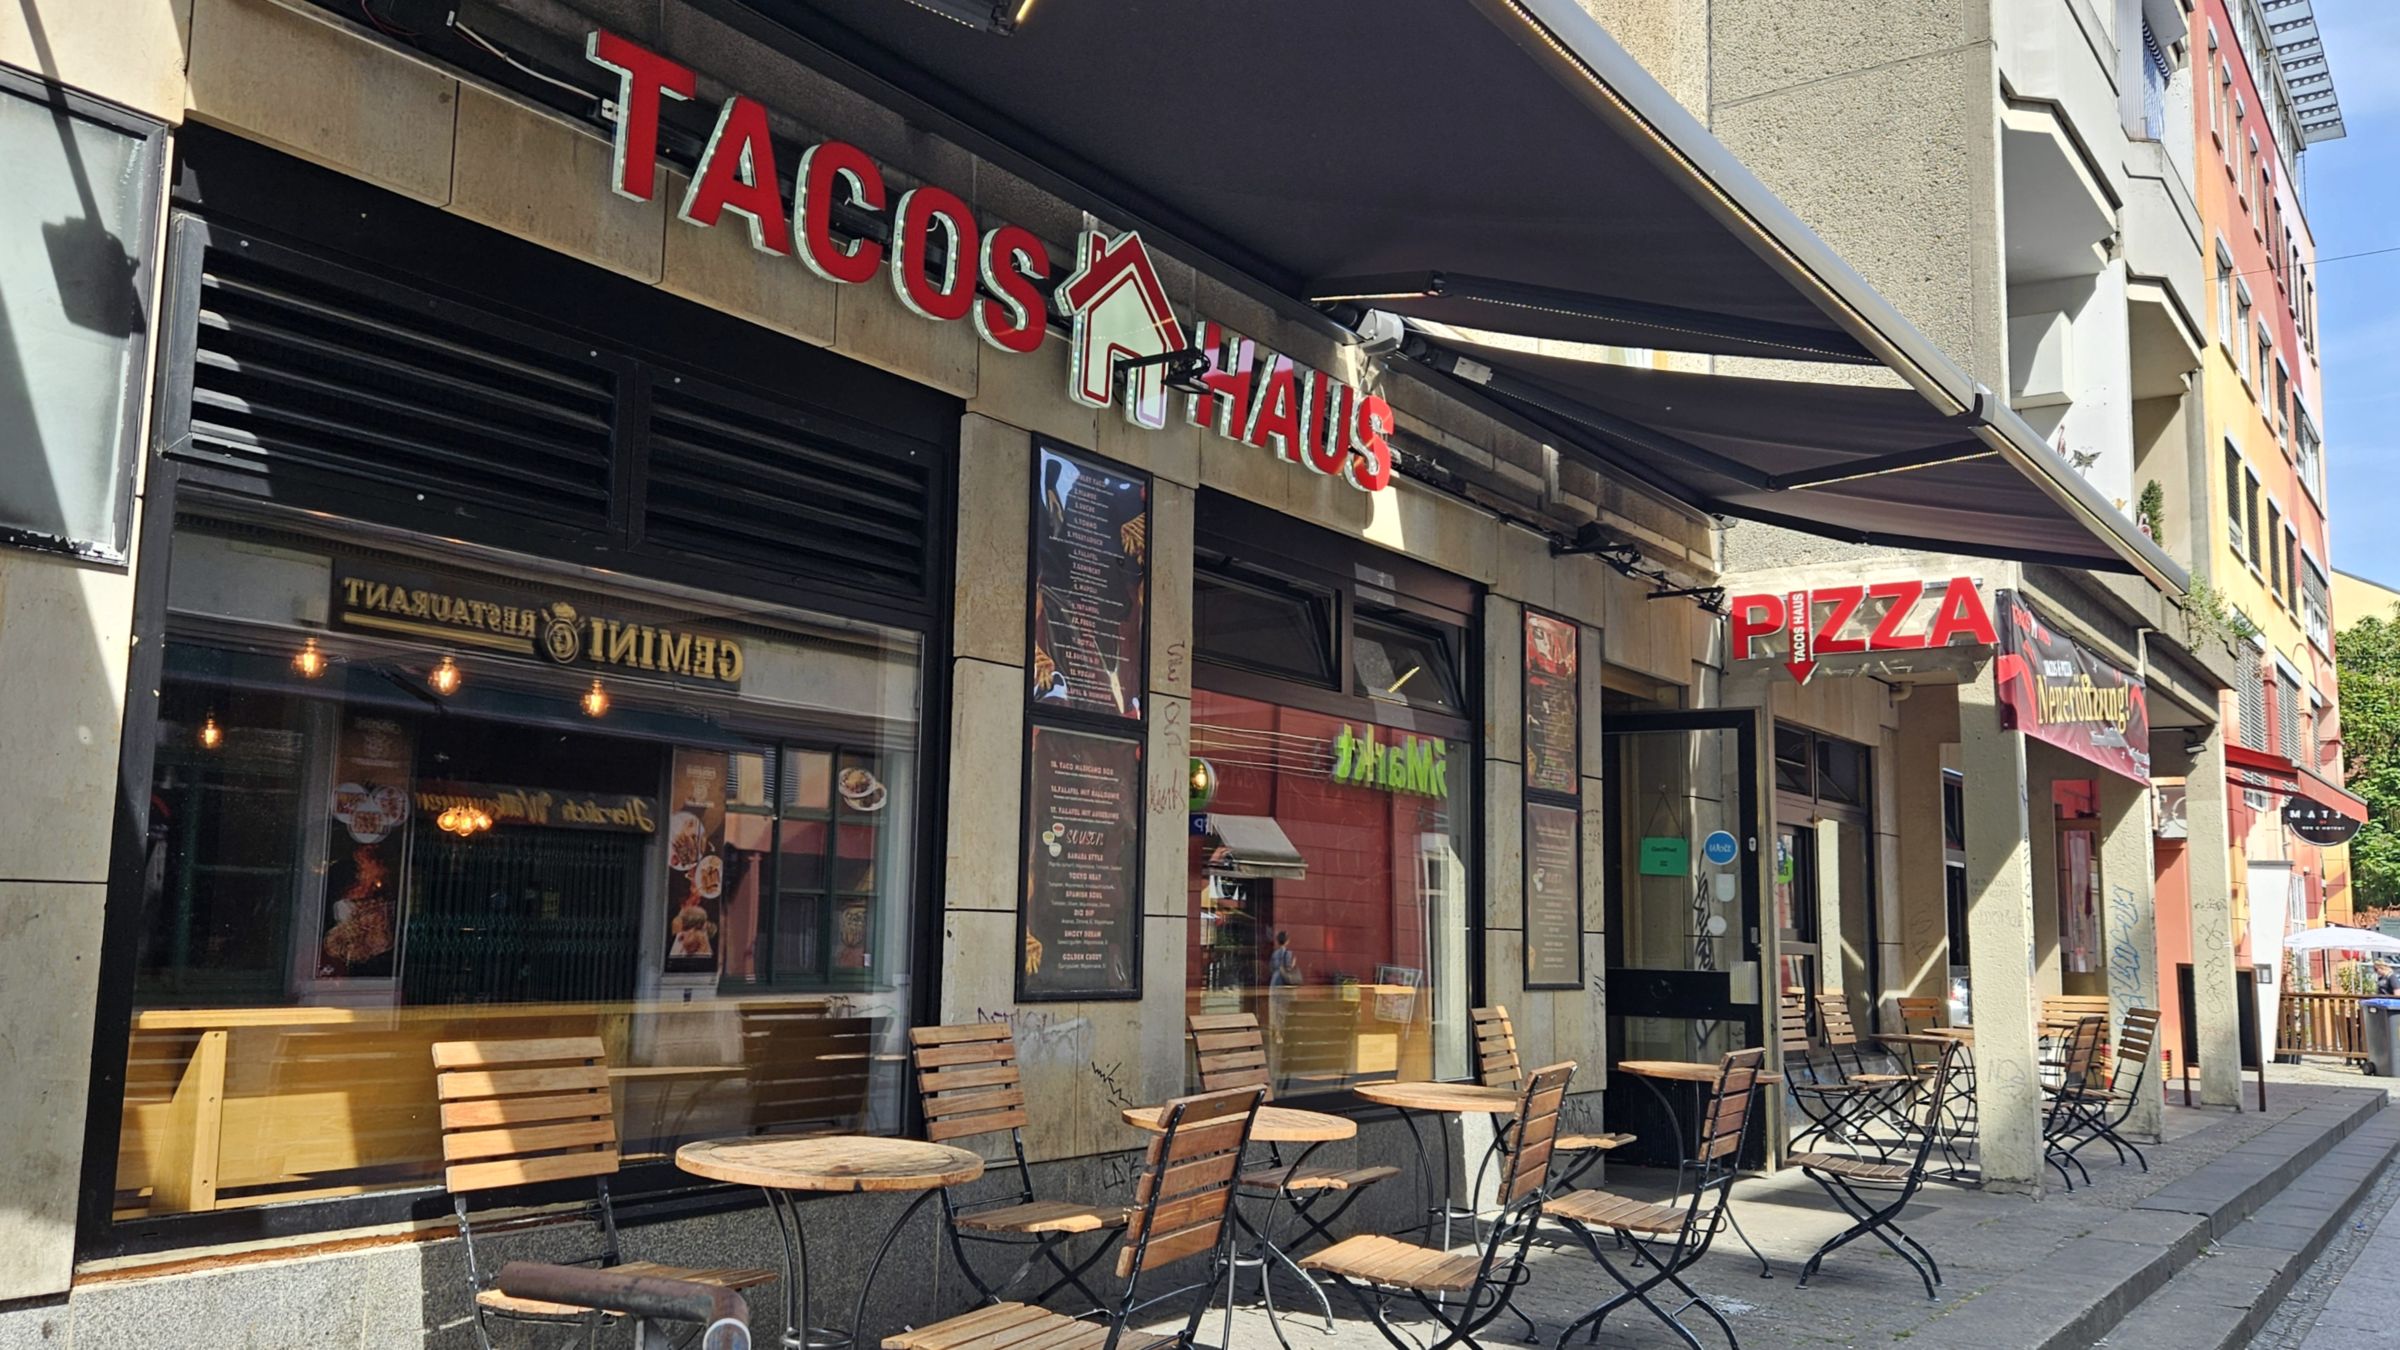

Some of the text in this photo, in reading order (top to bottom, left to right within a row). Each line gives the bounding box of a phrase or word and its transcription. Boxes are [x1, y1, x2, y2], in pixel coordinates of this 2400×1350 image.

[586, 29, 1396, 491] TACOS HAUS
[1731, 577, 2000, 659] PIZZA
[1794, 593, 1805, 664] TACOS HAUS
